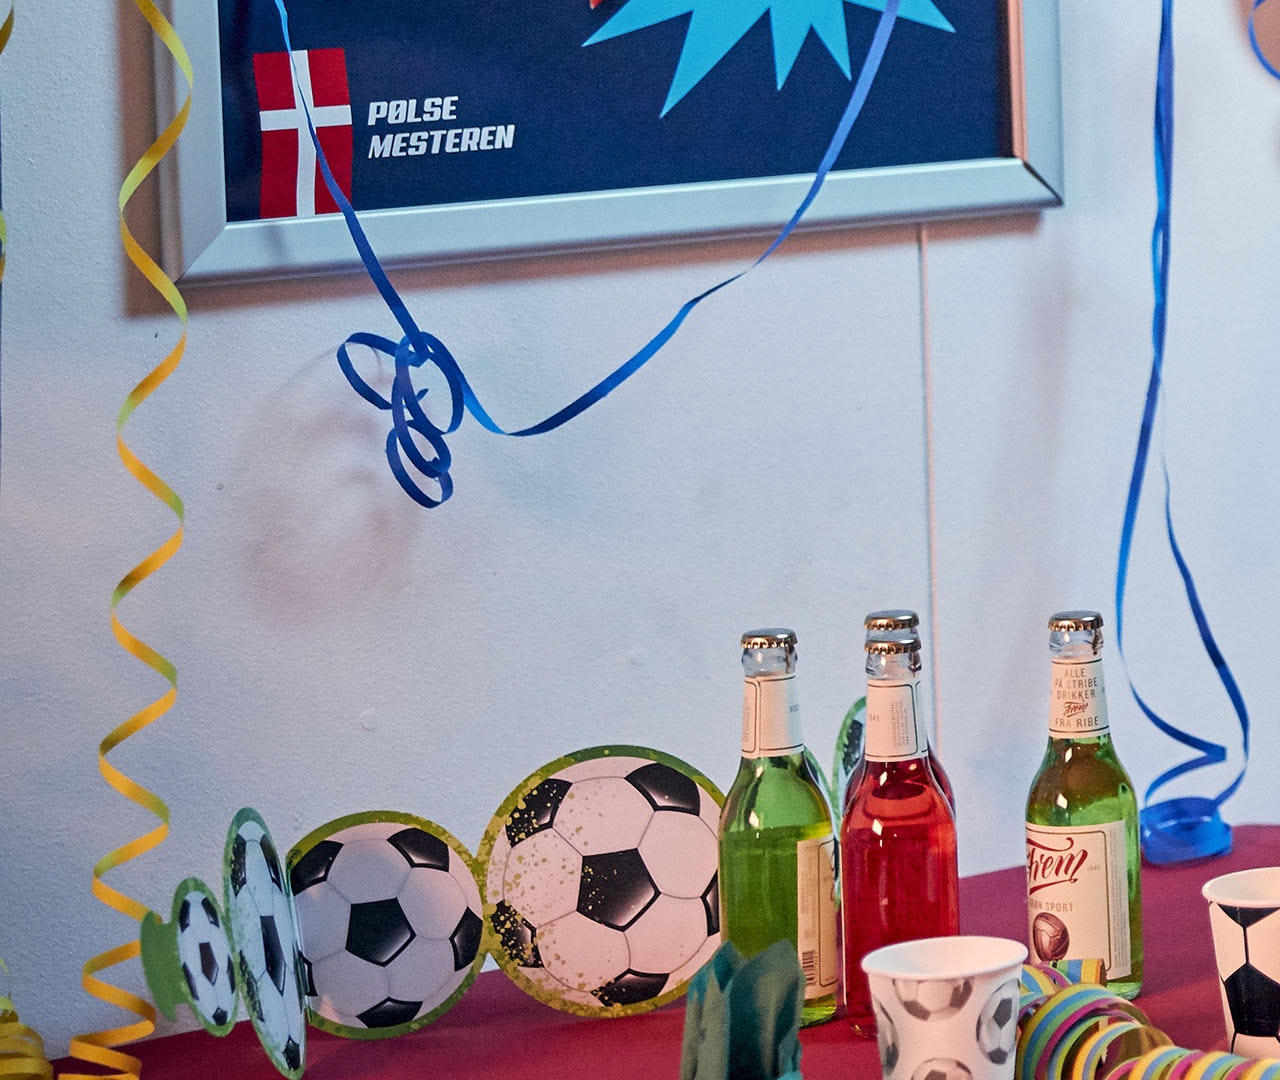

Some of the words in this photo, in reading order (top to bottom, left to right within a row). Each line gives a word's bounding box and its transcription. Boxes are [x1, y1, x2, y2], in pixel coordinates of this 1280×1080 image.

[367, 96, 459, 126] PØLSE
[367, 124, 515, 159] MESTEREN
[1064, 668, 1087, 678] ALLE
[1054, 678, 1063, 689] PÅ
[1066, 677, 1098, 689] STRIBE
[1056, 689, 1096, 700] DRIKKER
[1055, 717, 1071, 728] FRA
[1076, 716, 1099, 728] RIBE
[1045, 901, 1074, 913] SPORT
